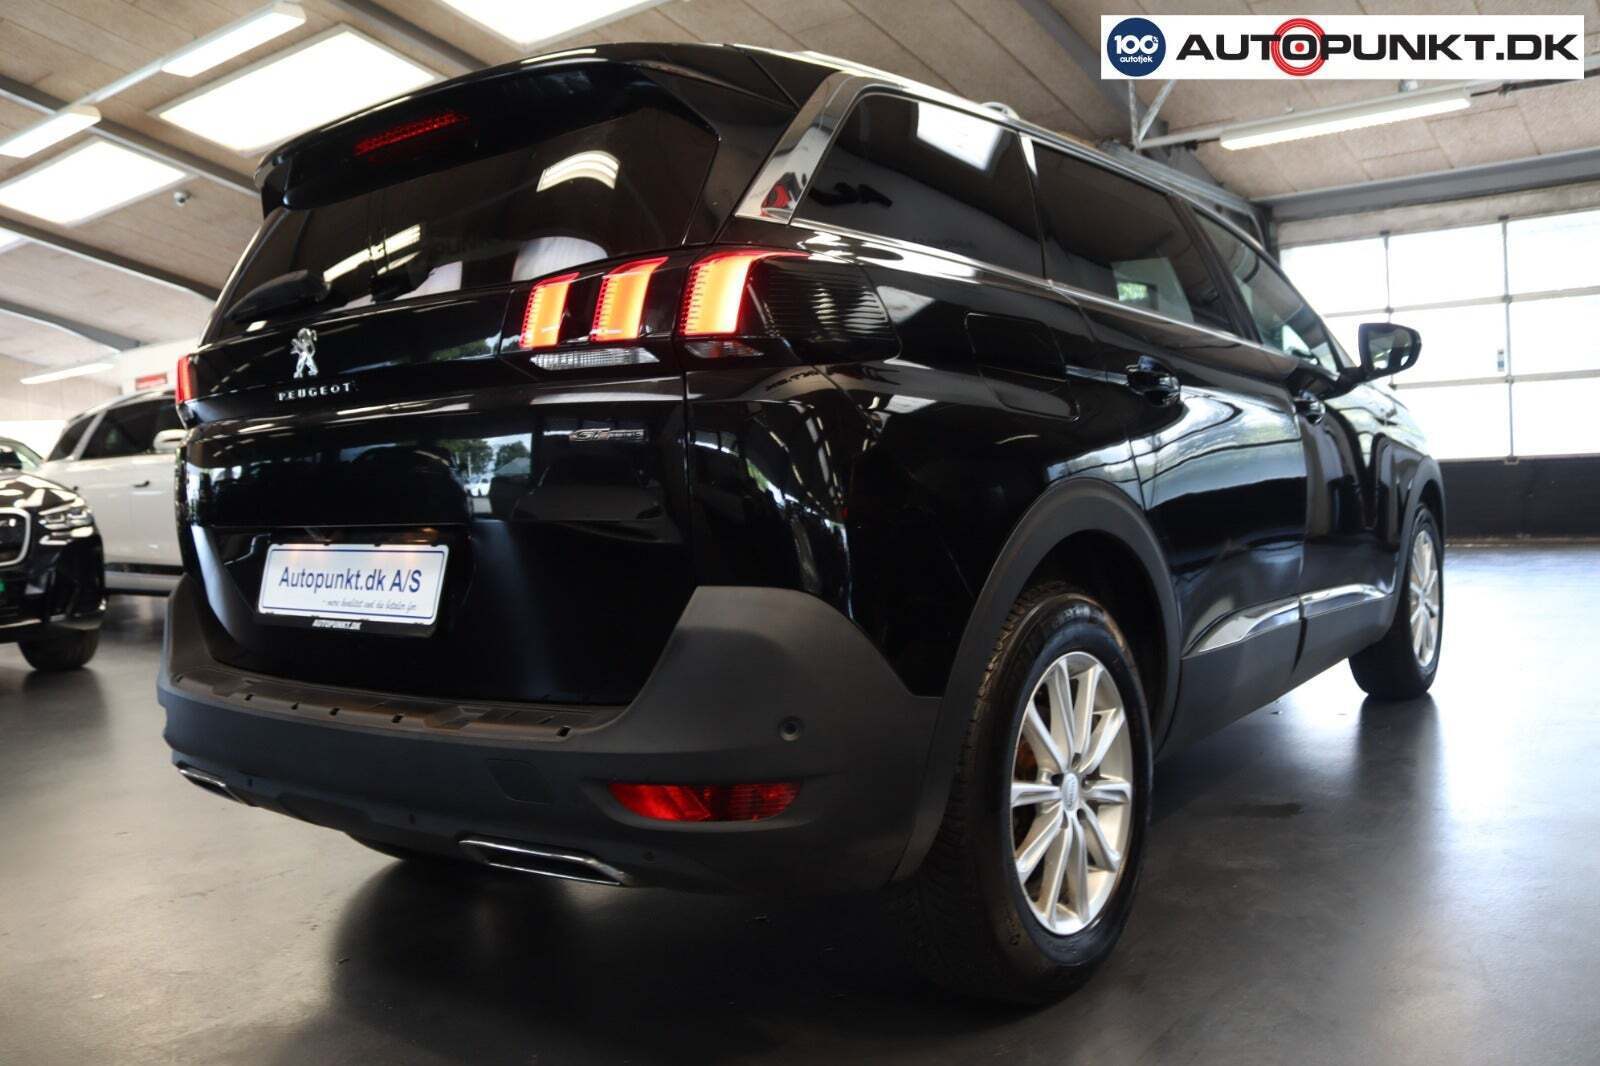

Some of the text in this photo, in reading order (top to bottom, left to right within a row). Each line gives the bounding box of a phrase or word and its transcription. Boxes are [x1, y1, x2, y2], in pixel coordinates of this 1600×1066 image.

[277, 382, 351, 401] PEUGEOT
[278, 566, 423, 594] Autopunkt.dk A/S
